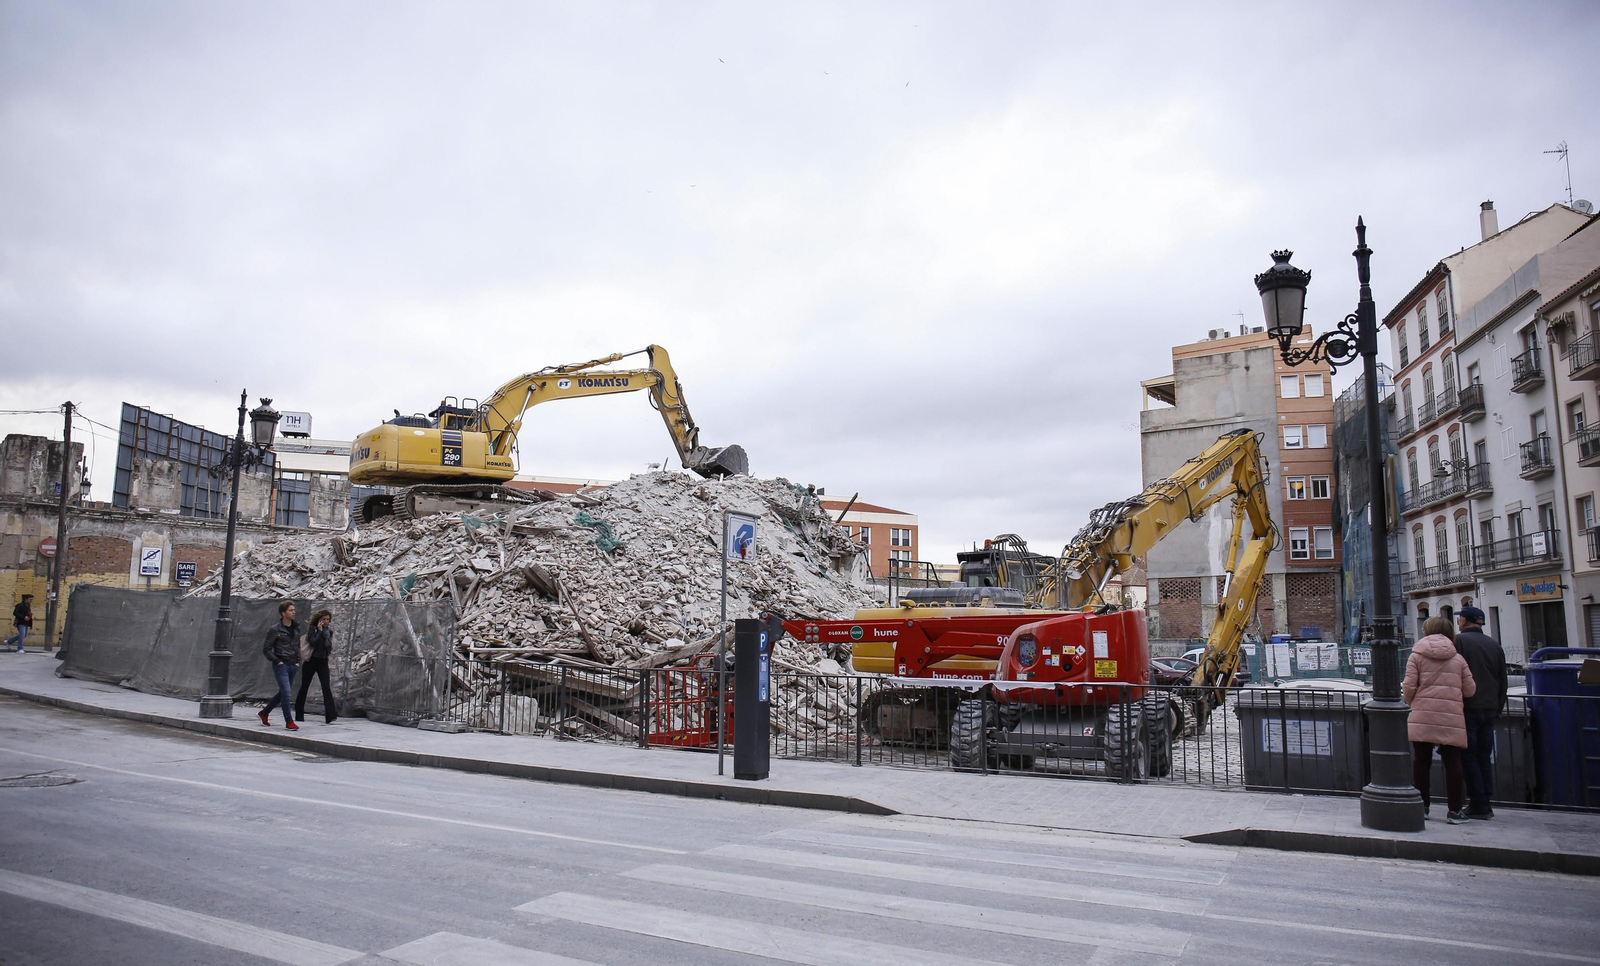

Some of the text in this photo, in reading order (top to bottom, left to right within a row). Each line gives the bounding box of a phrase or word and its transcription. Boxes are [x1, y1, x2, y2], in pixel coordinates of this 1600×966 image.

[578, 378, 628, 388] KOMATSU
[1206, 456, 1234, 484] KOMATSU
[874, 628, 898, 636] hune
[760, 633, 766, 648] P
[932, 671, 983, 680] hune.com
